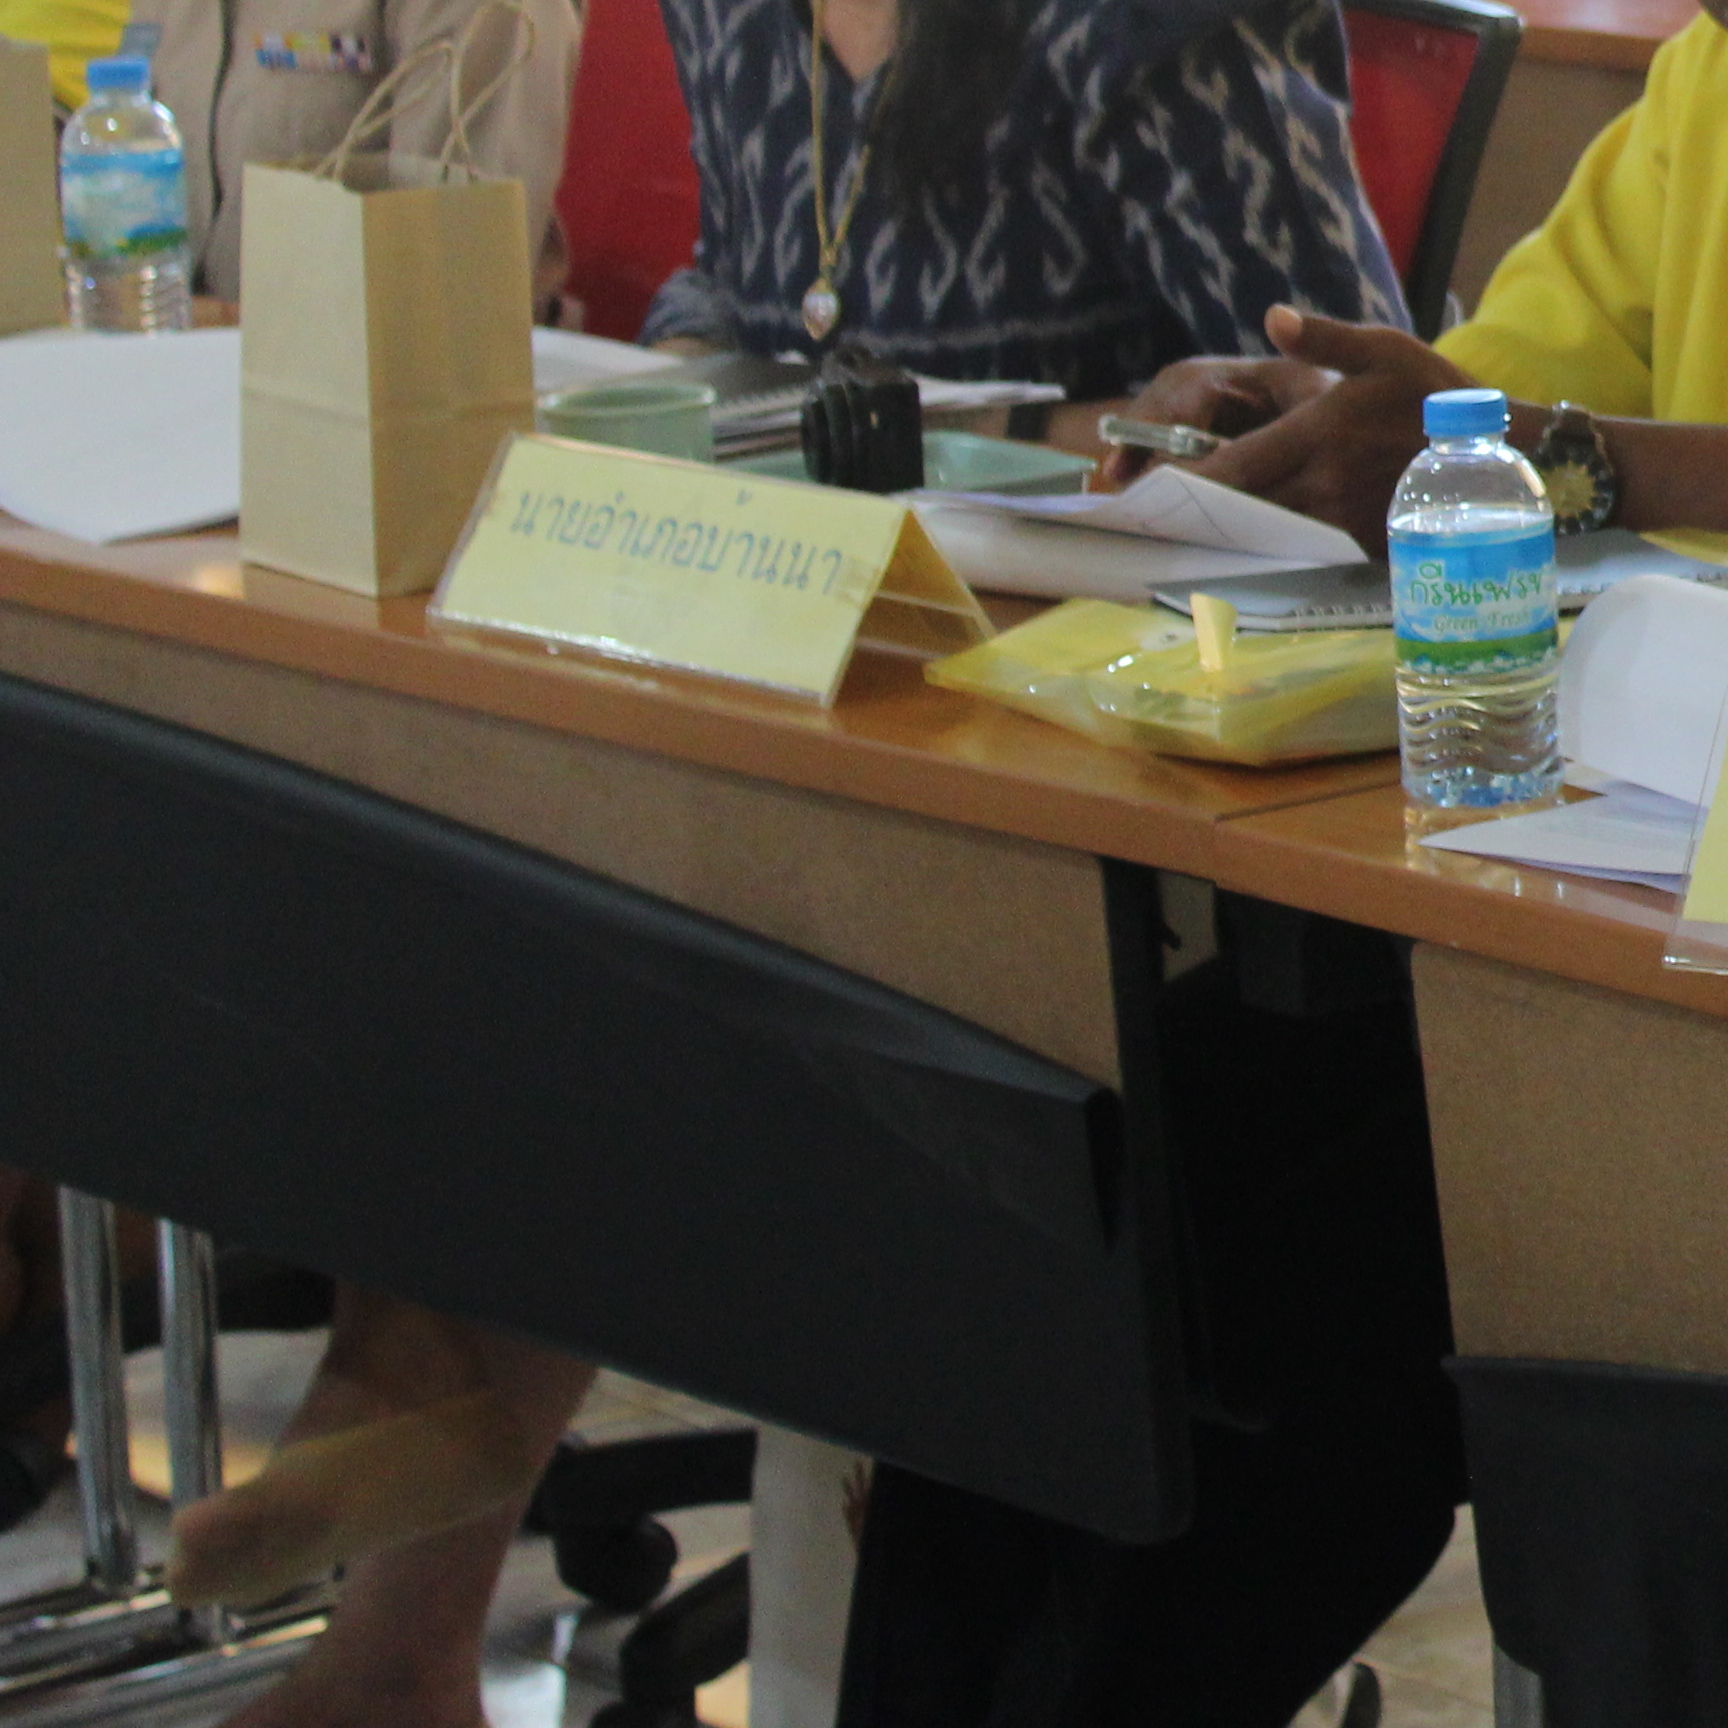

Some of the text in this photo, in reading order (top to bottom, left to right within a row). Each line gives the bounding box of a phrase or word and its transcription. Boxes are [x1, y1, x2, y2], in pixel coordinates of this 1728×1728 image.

[509, 489, 844, 596] นายอำเภอบ้านนา
